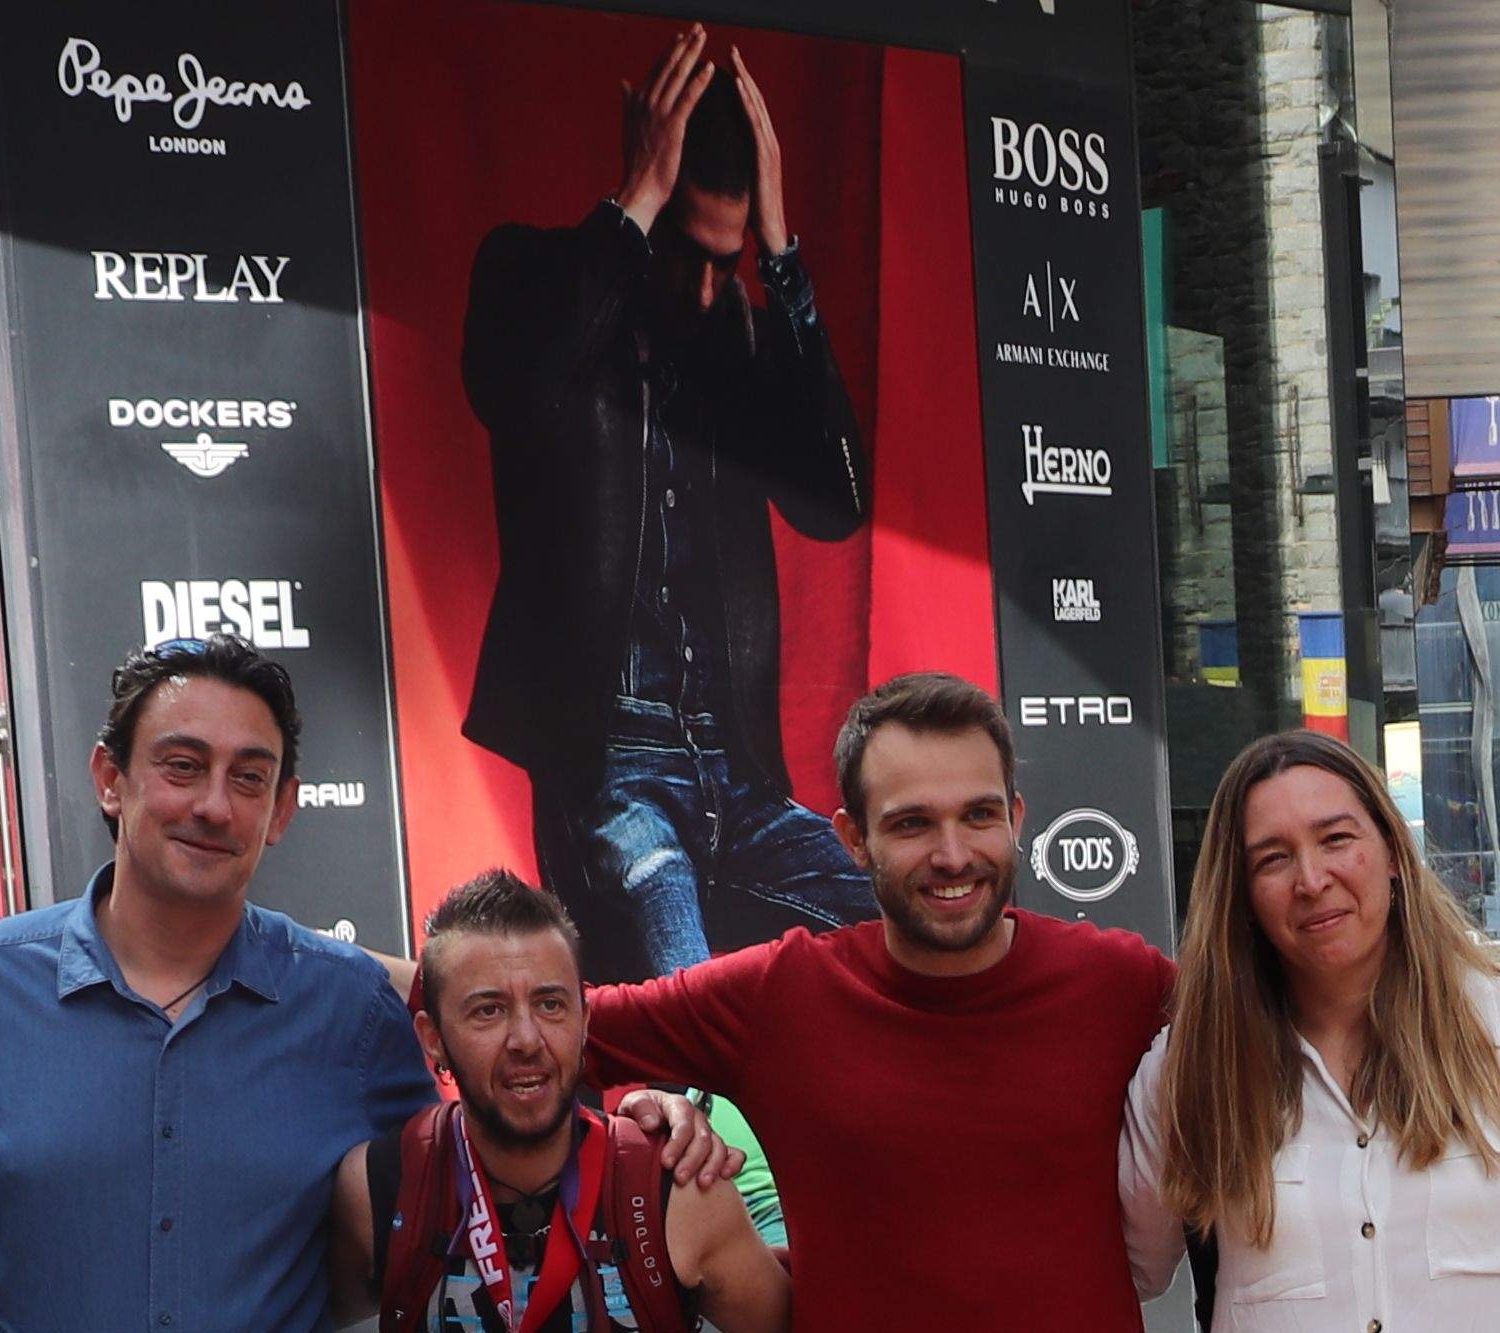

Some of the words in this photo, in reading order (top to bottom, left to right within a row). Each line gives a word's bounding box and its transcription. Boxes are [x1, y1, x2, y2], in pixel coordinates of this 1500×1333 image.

[57, 37, 172, 122] Pepe
[173, 53, 311, 129] Jeans
[148, 136, 226, 156] LONDON
[990, 116, 1109, 195] BOSS
[995, 187, 1048, 210] HUGO
[1060, 196, 1111, 219] BOSS
[91, 250, 290, 303] REPLAY
[995, 344, 1044, 366] ARMANI
[1048, 348, 1111, 373] EXCHANGE
[107, 398, 296, 428] DOCKERS
[1052, 579, 1100, 608] KARL
[140, 579, 310, 650] DIESEL
[1054, 606, 1101, 621] LAGERFELD
[298, 782, 365, 807] RAW
[1058, 838, 1114, 872] TOD'S
